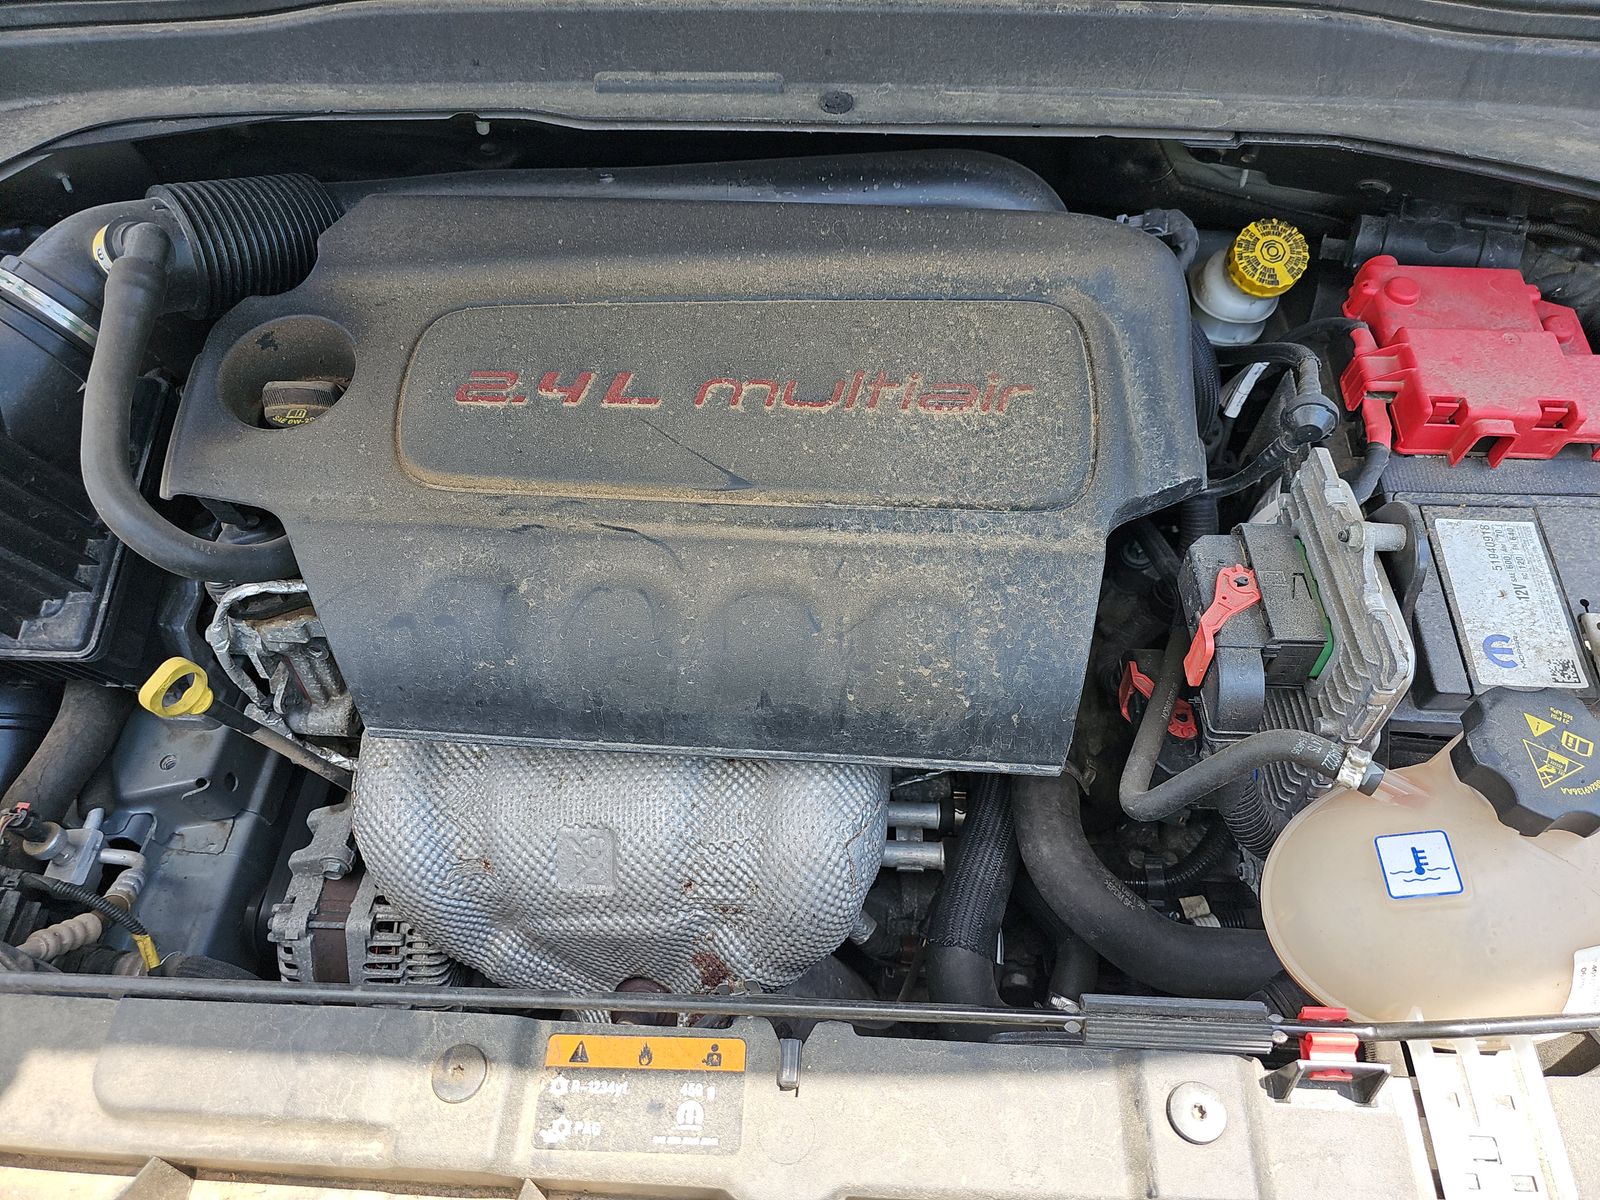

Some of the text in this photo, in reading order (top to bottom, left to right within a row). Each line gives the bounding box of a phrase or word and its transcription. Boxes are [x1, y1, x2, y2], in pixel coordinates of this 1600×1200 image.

[694, 371, 1035, 413] multiair
[1507, 527, 1517, 541] 640
[1480, 524, 1503, 572] 51940918
[1512, 583, 1530, 601] 12V
[1512, 635, 1528, 671] MOPAR
[573, 1120, 601, 1136] PAG
